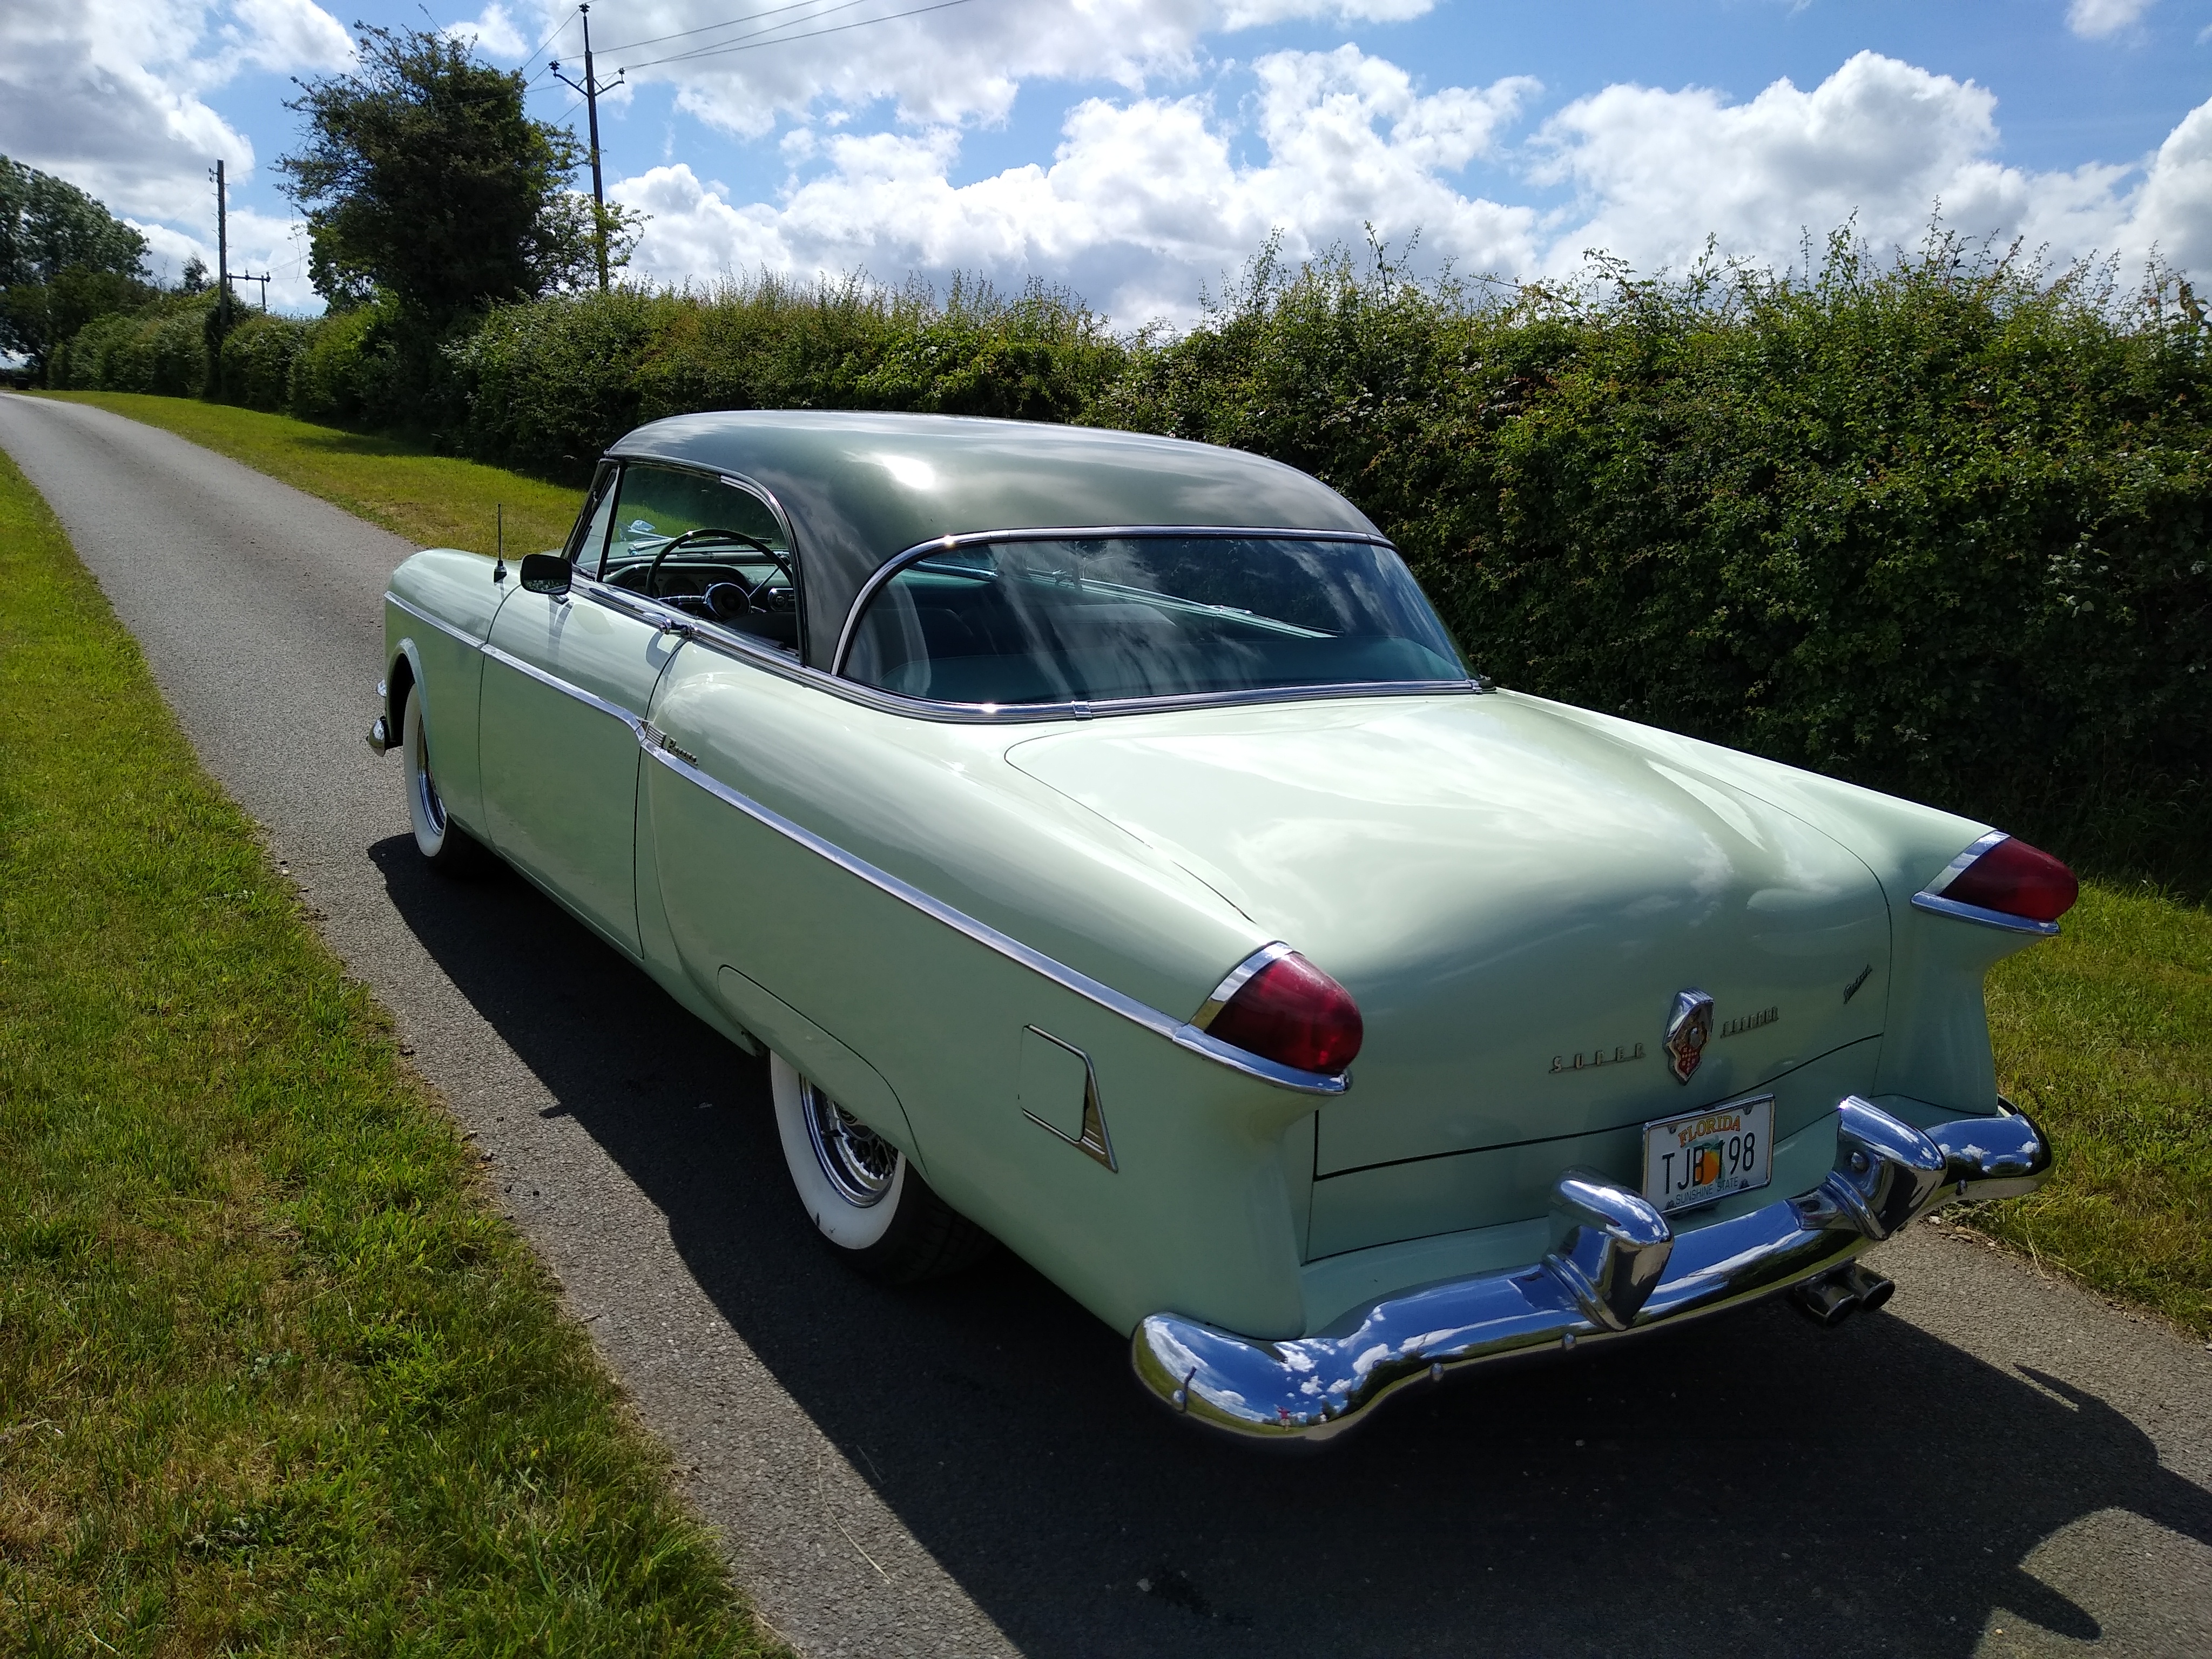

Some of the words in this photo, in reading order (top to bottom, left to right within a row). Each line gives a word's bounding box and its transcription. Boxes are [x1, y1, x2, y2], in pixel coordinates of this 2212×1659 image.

[1552, 1043, 1645, 1072] SUPER
[1677, 1115, 1741, 1148] FLORIDA
[1662, 1145, 1704, 1195] TJB
[1716, 1132, 1756, 1179] 198
[1675, 1185, 1713, 1205] SUNSHINE
[1717, 1176, 1739, 1192] STATE
